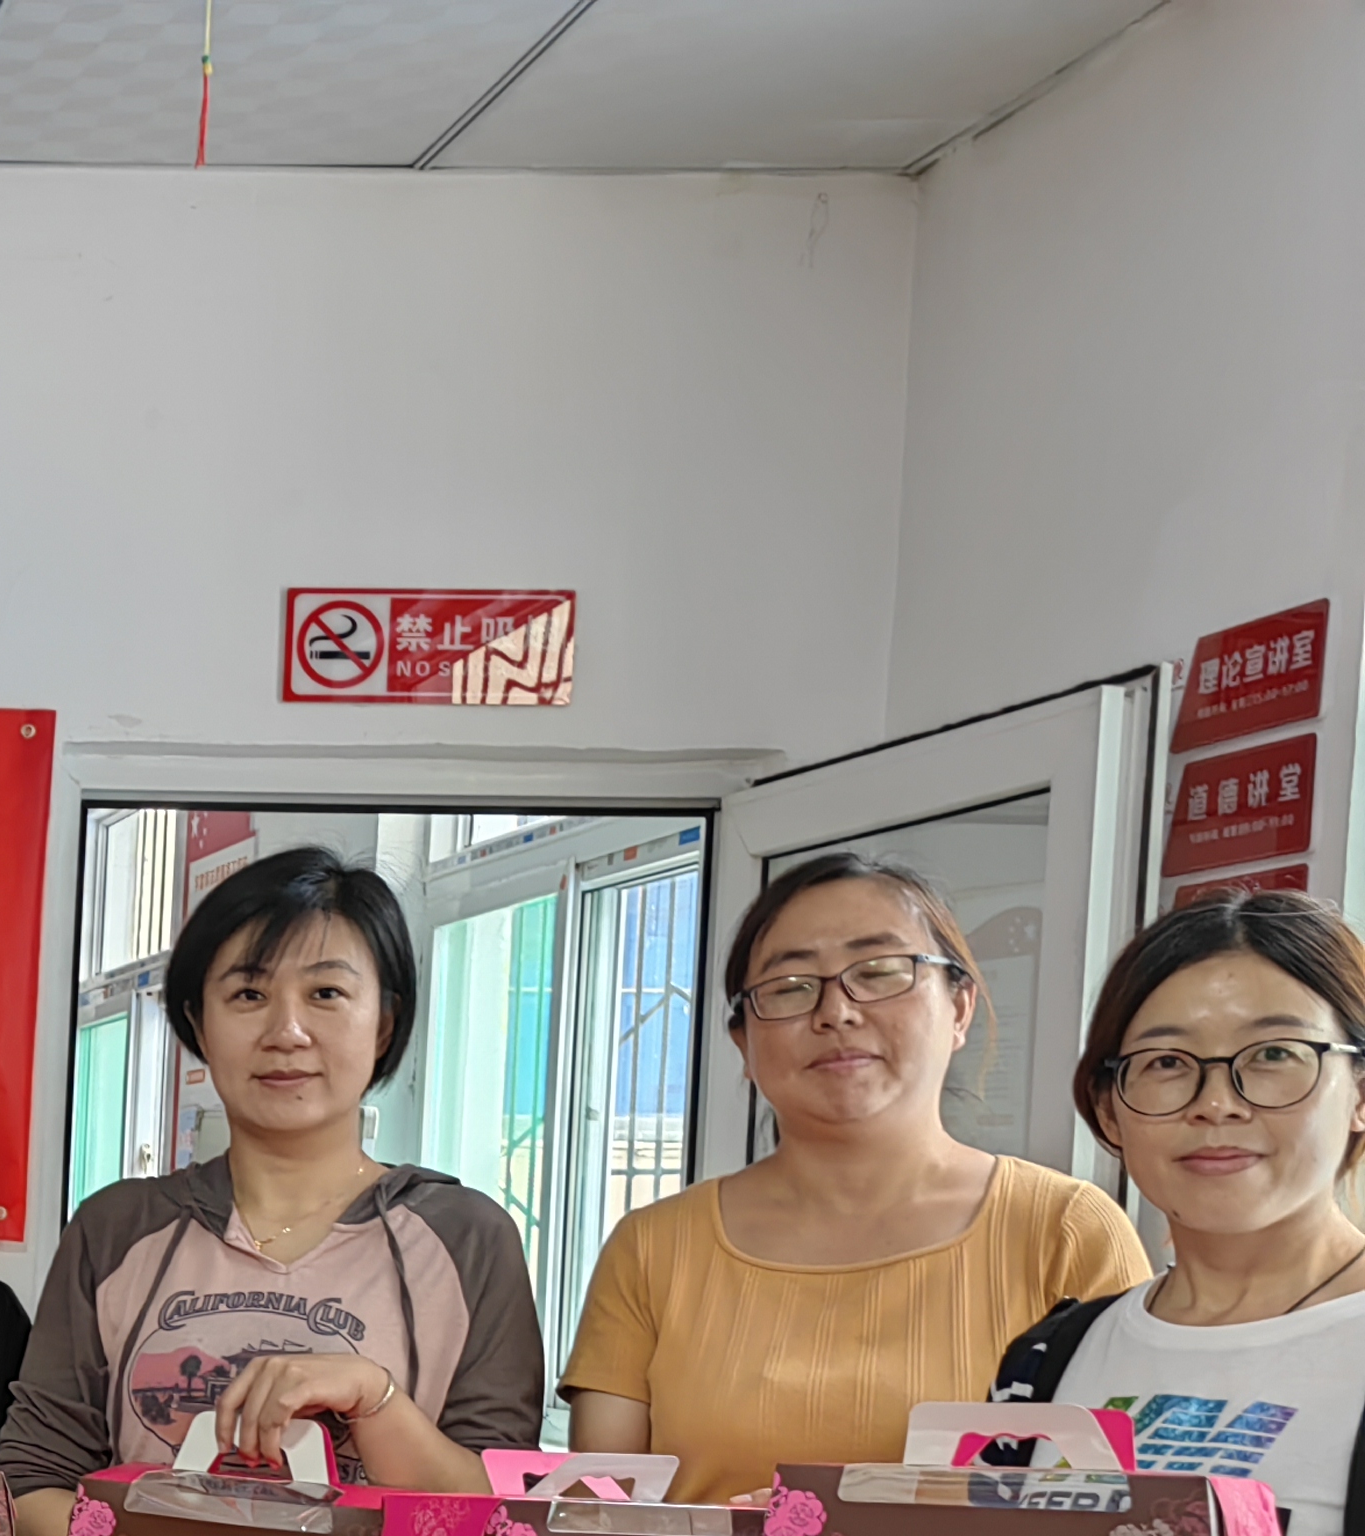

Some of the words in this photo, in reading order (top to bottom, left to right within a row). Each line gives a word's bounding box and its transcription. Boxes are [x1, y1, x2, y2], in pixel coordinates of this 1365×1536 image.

[396, 661, 430, 677] NO
[1187, 762, 1303, 822] 道德讲堂
[158, 1290, 308, 1332] CALIFORNIA
[306, 1297, 367, 1342] CLUB
